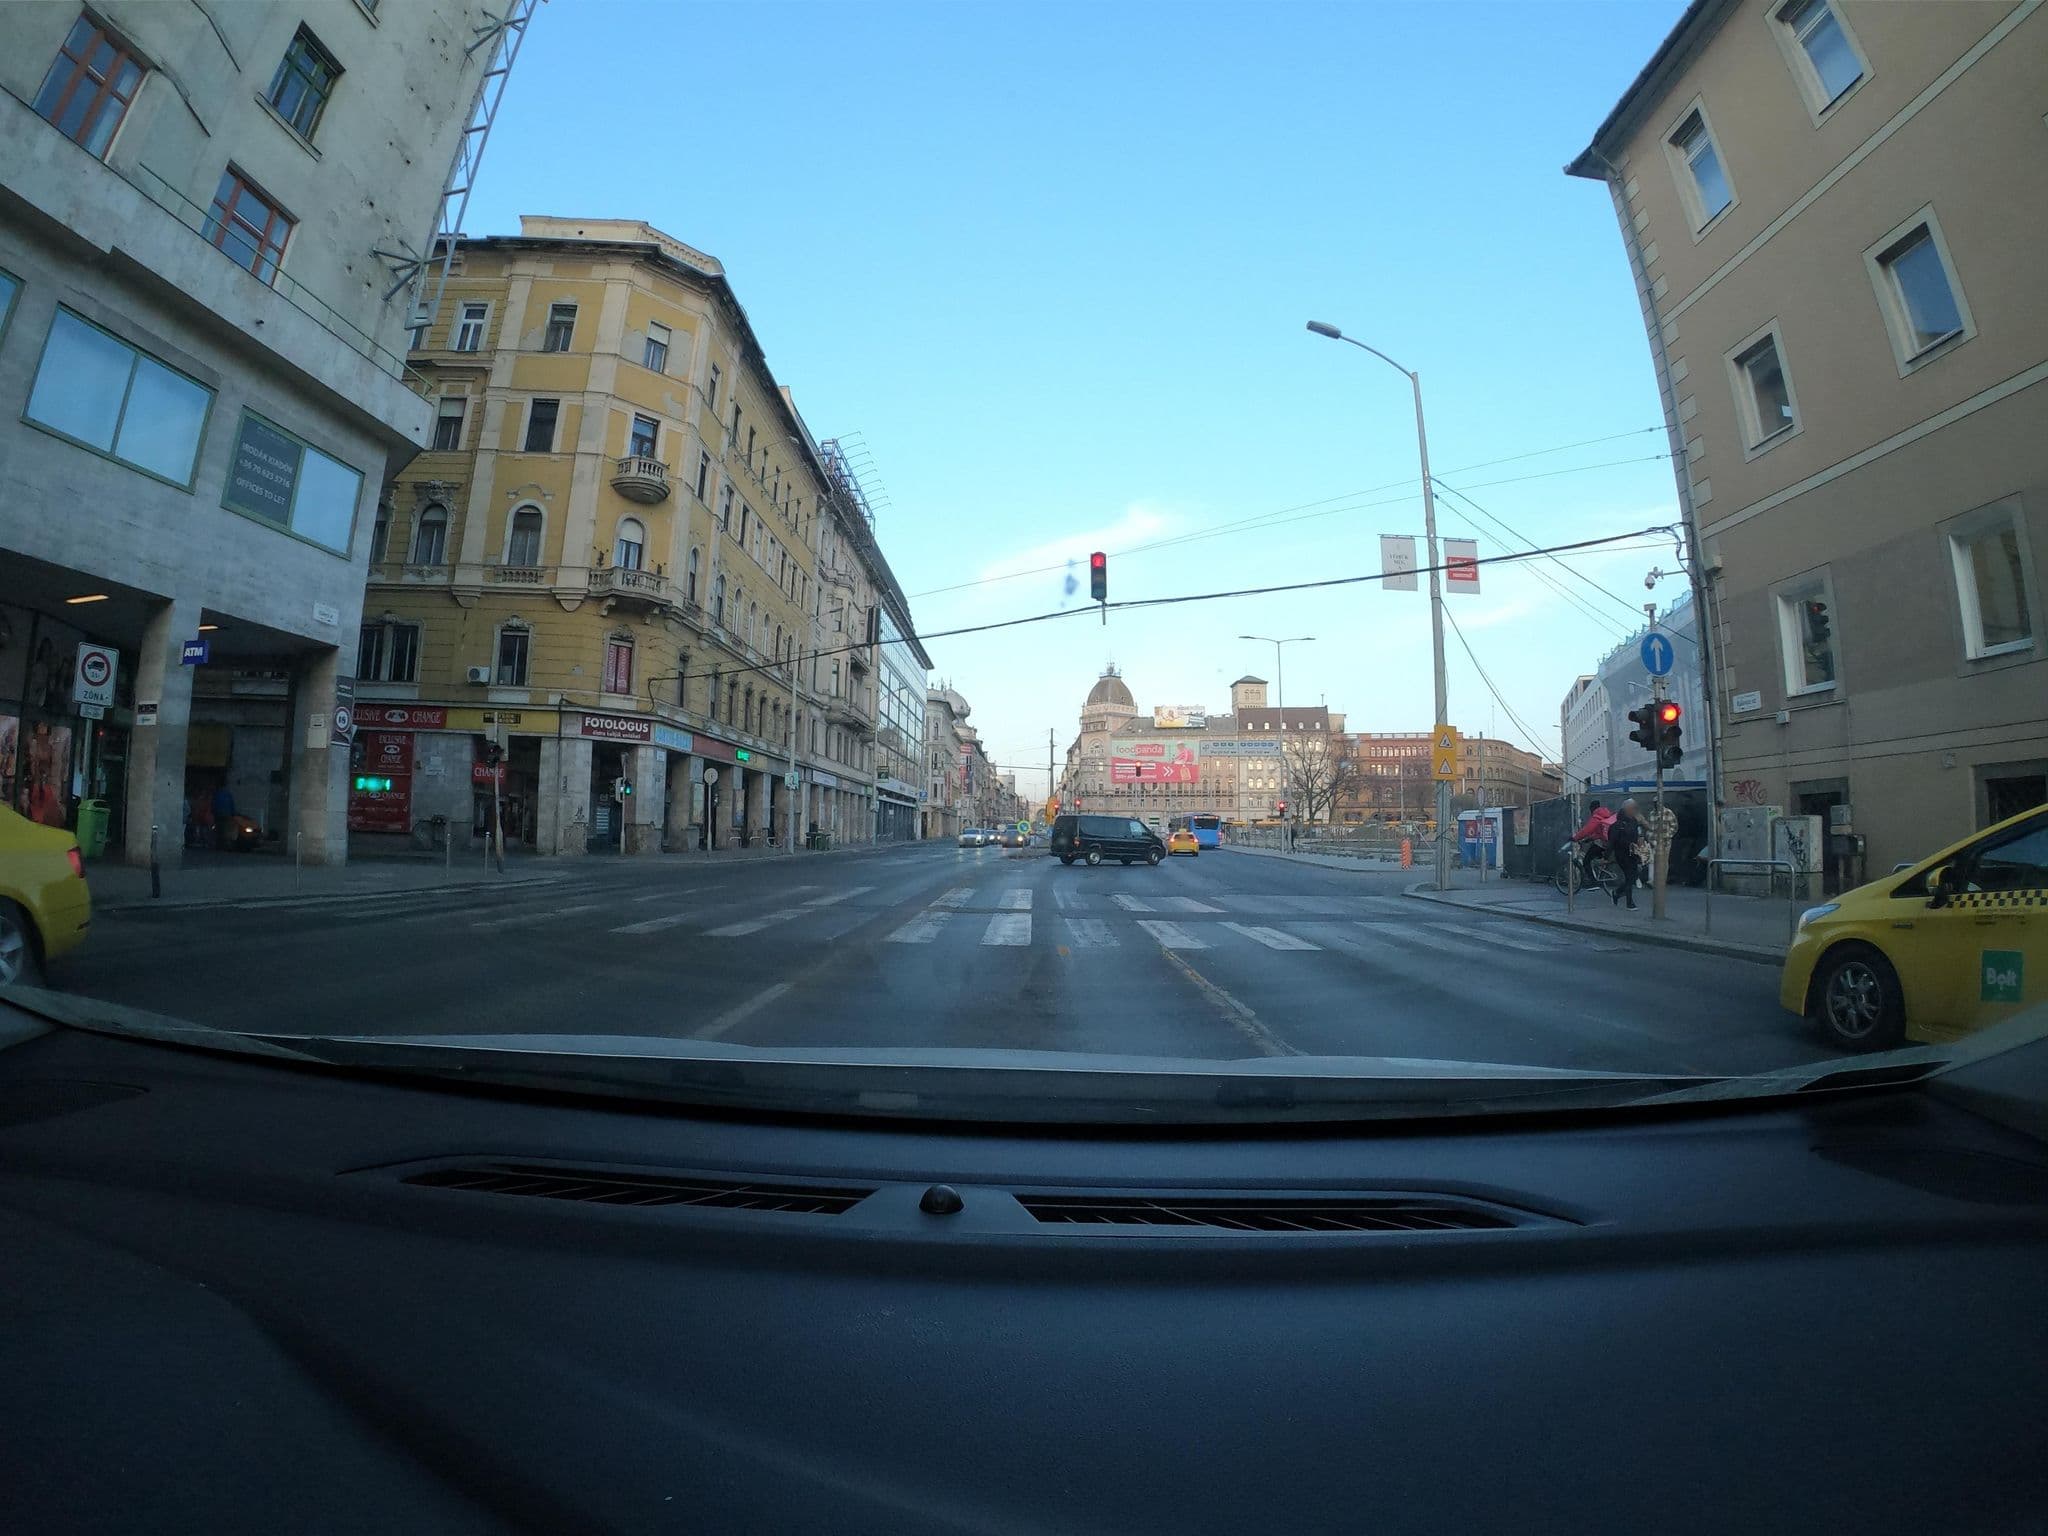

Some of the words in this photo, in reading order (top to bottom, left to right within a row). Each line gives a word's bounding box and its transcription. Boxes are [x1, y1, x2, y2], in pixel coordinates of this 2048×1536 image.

[236, 476, 264, 496] OFFICES
[264, 489, 273, 500] TO
[273, 494, 286, 505] LET
[184, 647, 203, 657] ATM
[412, 711, 441, 724] CHANGE
[585, 717, 649, 733] FOTOLÓGUS
[1116, 744, 1163, 754] foodpanda
[1986, 967, 2017, 987] Bolt
